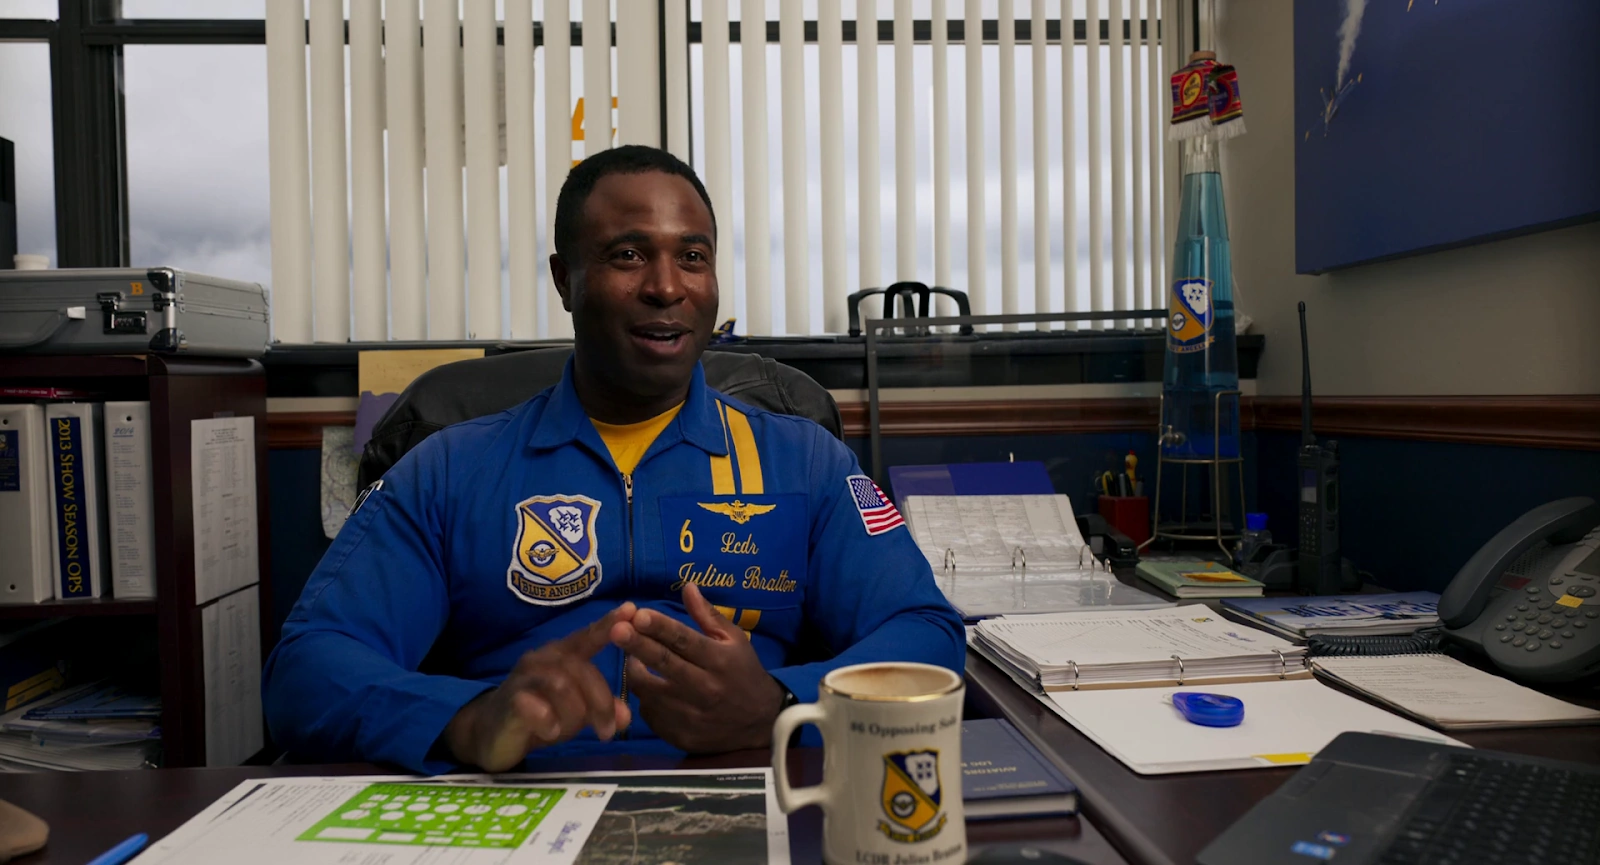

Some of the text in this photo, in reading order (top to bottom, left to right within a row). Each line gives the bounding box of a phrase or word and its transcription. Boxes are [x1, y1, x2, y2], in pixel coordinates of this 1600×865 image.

[130, 282, 144, 296] B
[113, 426, 135, 436] 2014
[57, 419, 84, 593] 2013 SHOW SEASON OPS
[680, 519, 694, 554] 6
[720, 532, 759, 555] Lcdr
[520, 577, 588, 598] BLUE ANGELS
[670, 562, 797, 594] Julius Bratton
[867, 722, 936, 738] Opposing
[855, 849, 890, 865] LCDR
[893, 851, 931, 865] Julius
